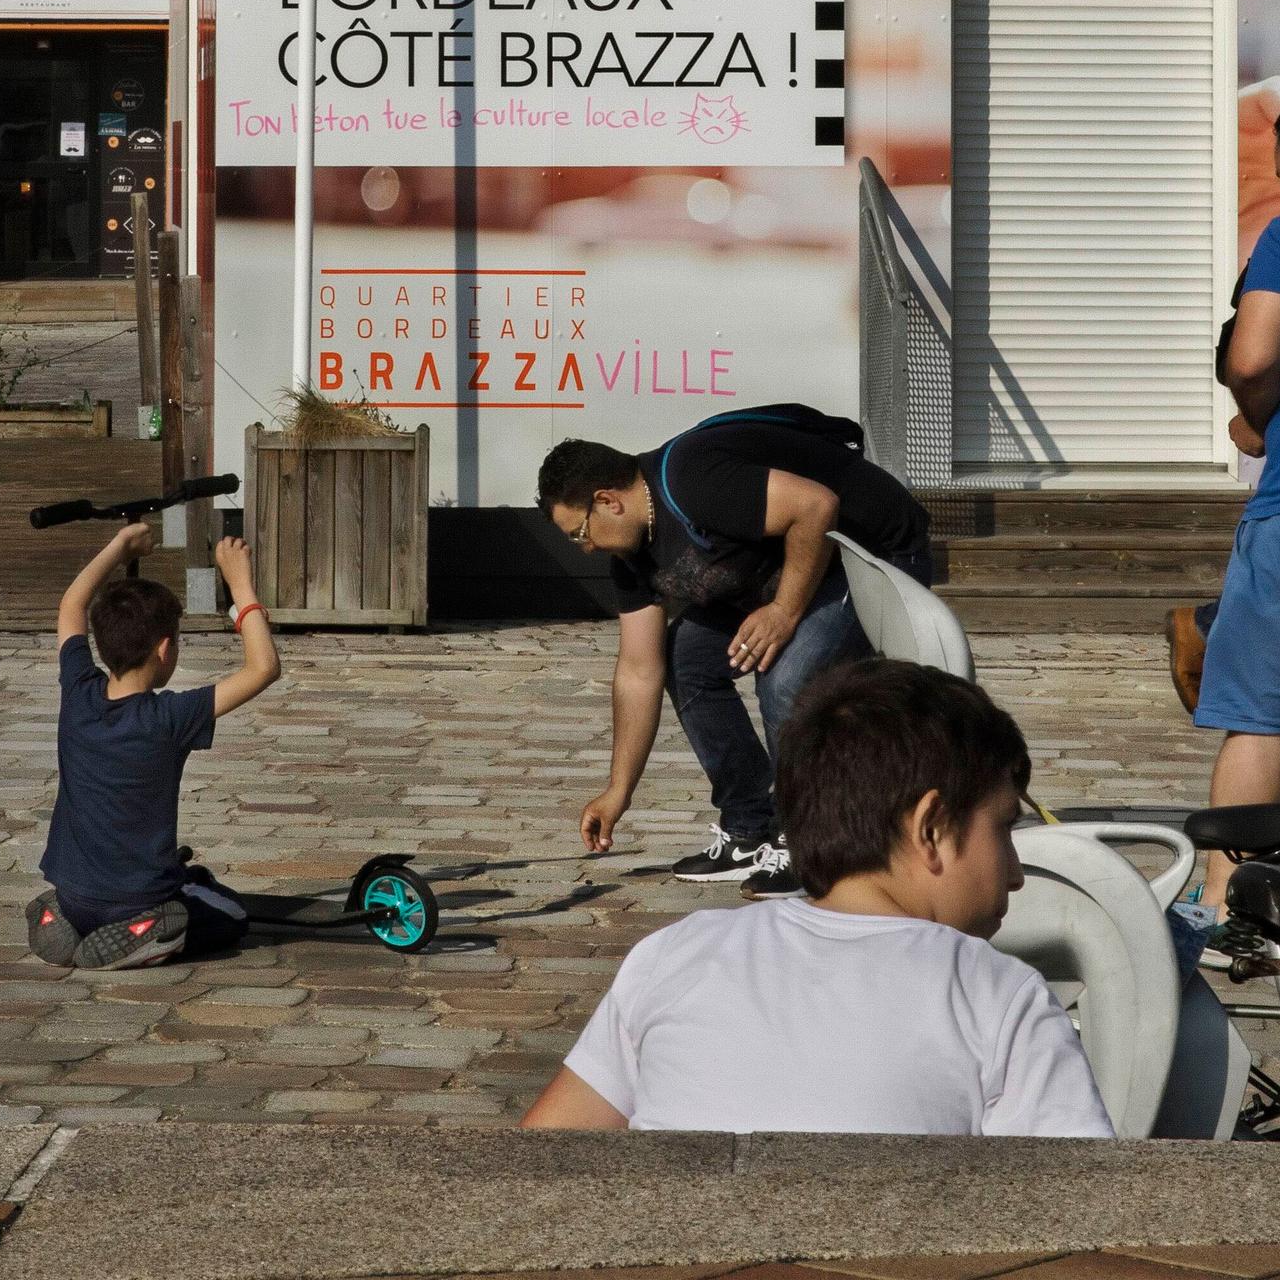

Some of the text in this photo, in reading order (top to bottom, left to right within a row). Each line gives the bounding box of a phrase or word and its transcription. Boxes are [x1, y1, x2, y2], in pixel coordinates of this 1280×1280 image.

[278, 18, 799, 89] CÔTÉ BRAZZA !
[385, 98, 428, 130] tue
[440, 97, 464, 128] la
[474, 98, 571, 128] culture
[584, 95, 668, 128] locale
[320, 286, 586, 308] QUARTIER
[320, 318, 586, 340] BORDEAUX
[320, 351, 584, 392] BRAZZA
